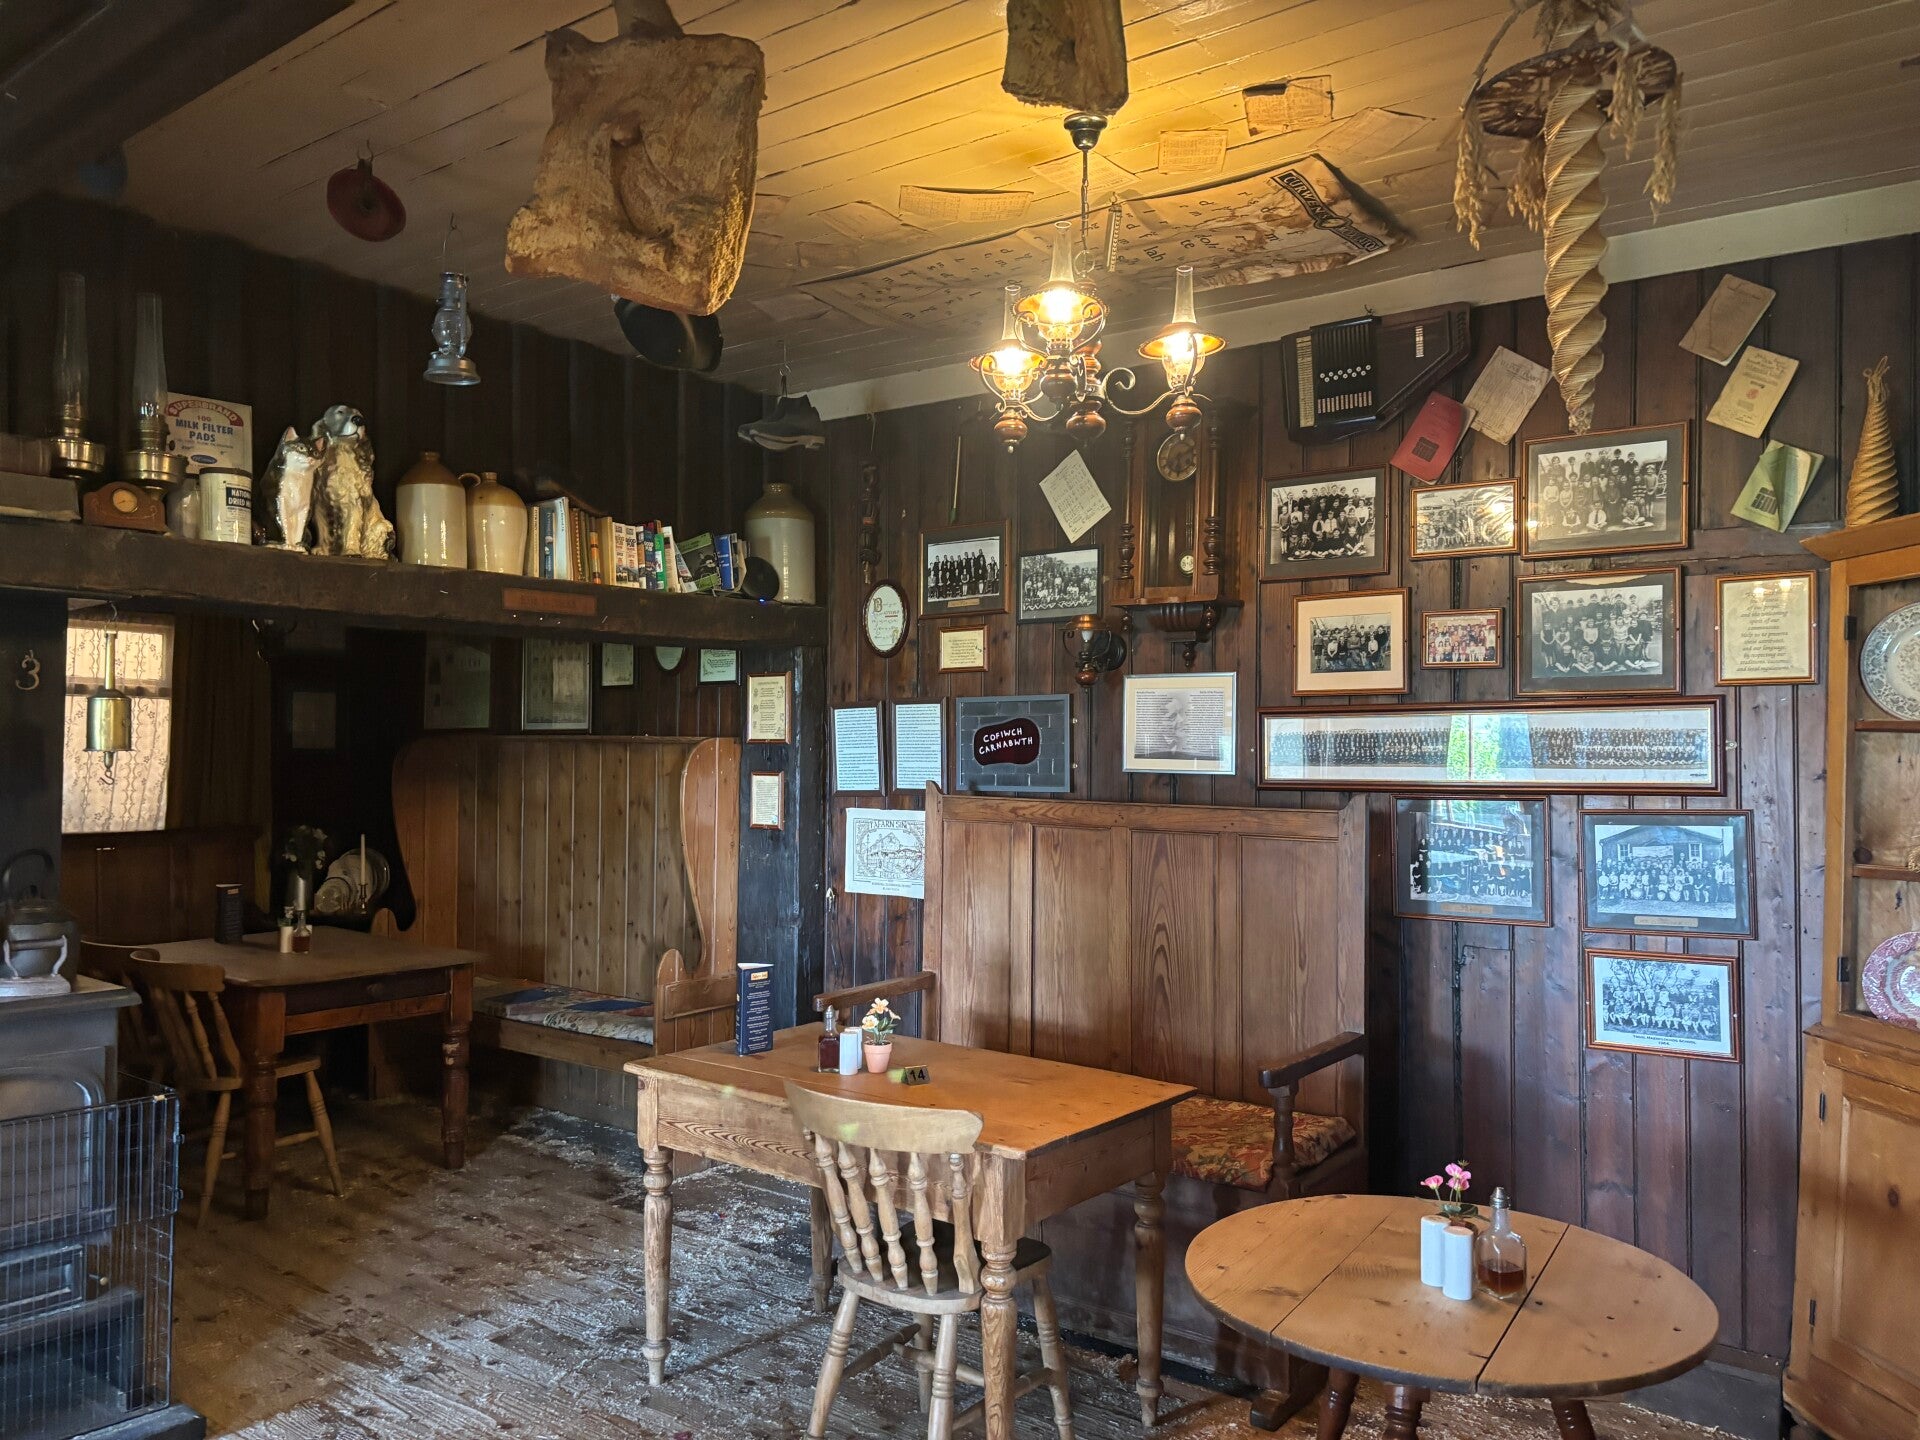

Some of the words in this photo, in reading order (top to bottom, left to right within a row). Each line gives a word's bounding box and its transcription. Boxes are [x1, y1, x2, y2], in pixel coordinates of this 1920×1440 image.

[176, 419, 198, 429] MILK
[203, 423, 233, 435] FILTER
[189, 431, 215, 442] PADS
[983, 728, 1022, 743] COFIWCH
[979, 737, 1033, 754] CARNABWTH
[910, 1069, 926, 1080] 14
